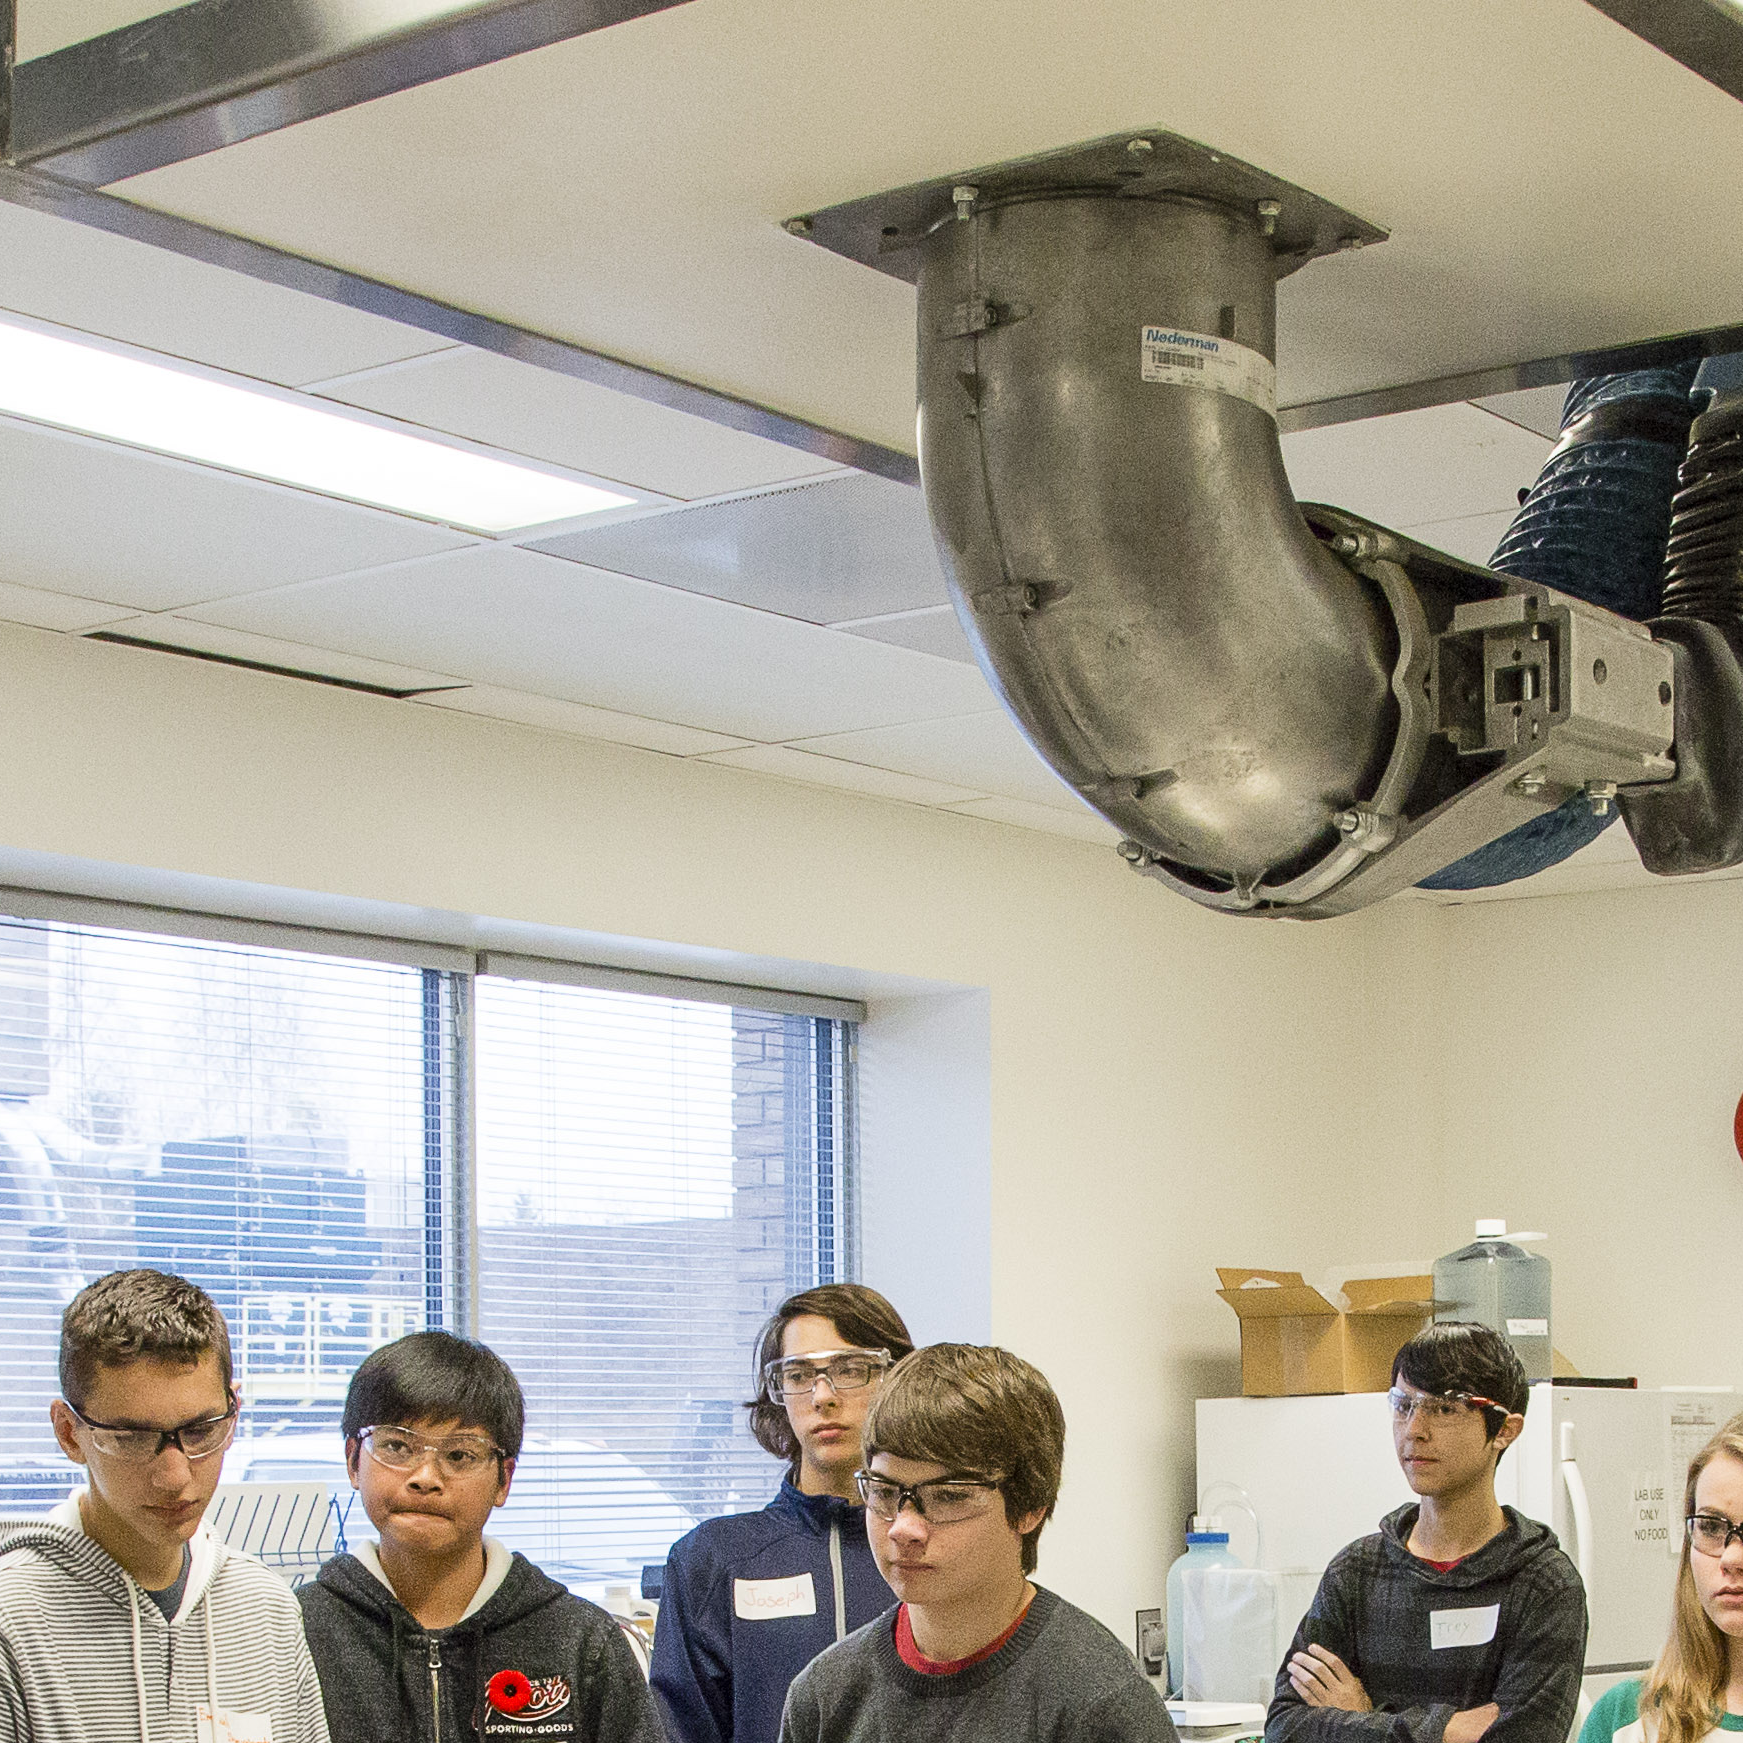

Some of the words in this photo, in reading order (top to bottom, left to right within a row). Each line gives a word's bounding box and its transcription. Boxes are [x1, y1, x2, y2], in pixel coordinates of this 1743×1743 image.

[1146, 329, 1219, 352] Nederman
[1634, 1489, 1648, 1501] LAB
[1650, 1488, 1664, 1500] USE
[1639, 1509, 1660, 1520] ONLY
[1634, 1529, 1646, 1541] NO
[1647, 1528, 1668, 1541] FOOD
[743, 1583, 806, 1608] Joseph
[1436, 1622, 1470, 1640] Trey
[485, 1725, 534, 1735] SPORTING
[537, 1723, 574, 1734] GOODS
